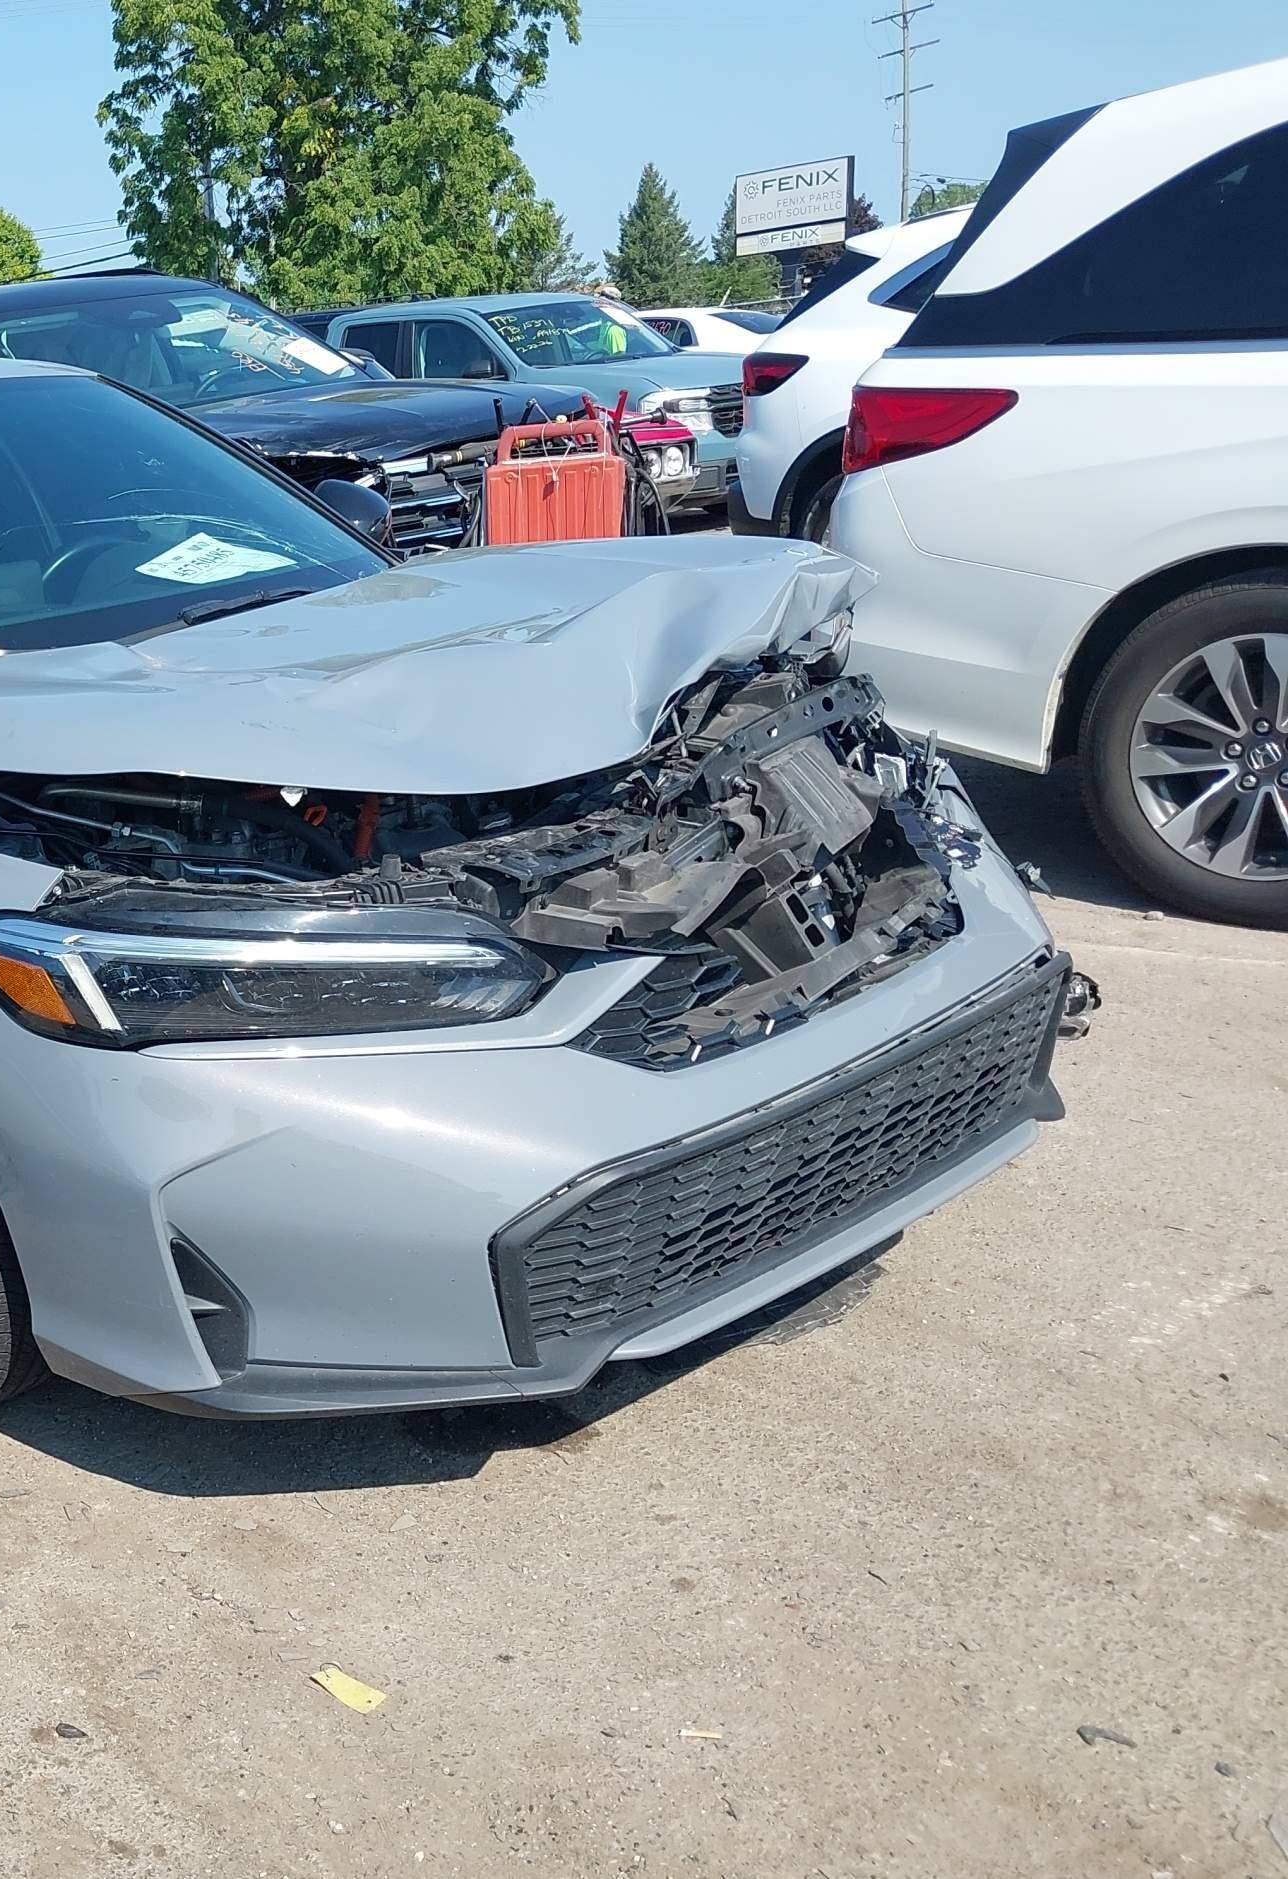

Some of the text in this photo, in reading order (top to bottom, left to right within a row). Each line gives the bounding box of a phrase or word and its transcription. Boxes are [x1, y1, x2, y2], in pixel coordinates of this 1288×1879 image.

[762, 168, 839, 194] FENIX
[777, 190, 842, 208] FENIX PARTS
[741, 200, 842, 224] DETROIT SOUTH LLC
[771, 227, 819, 243] FENIX
